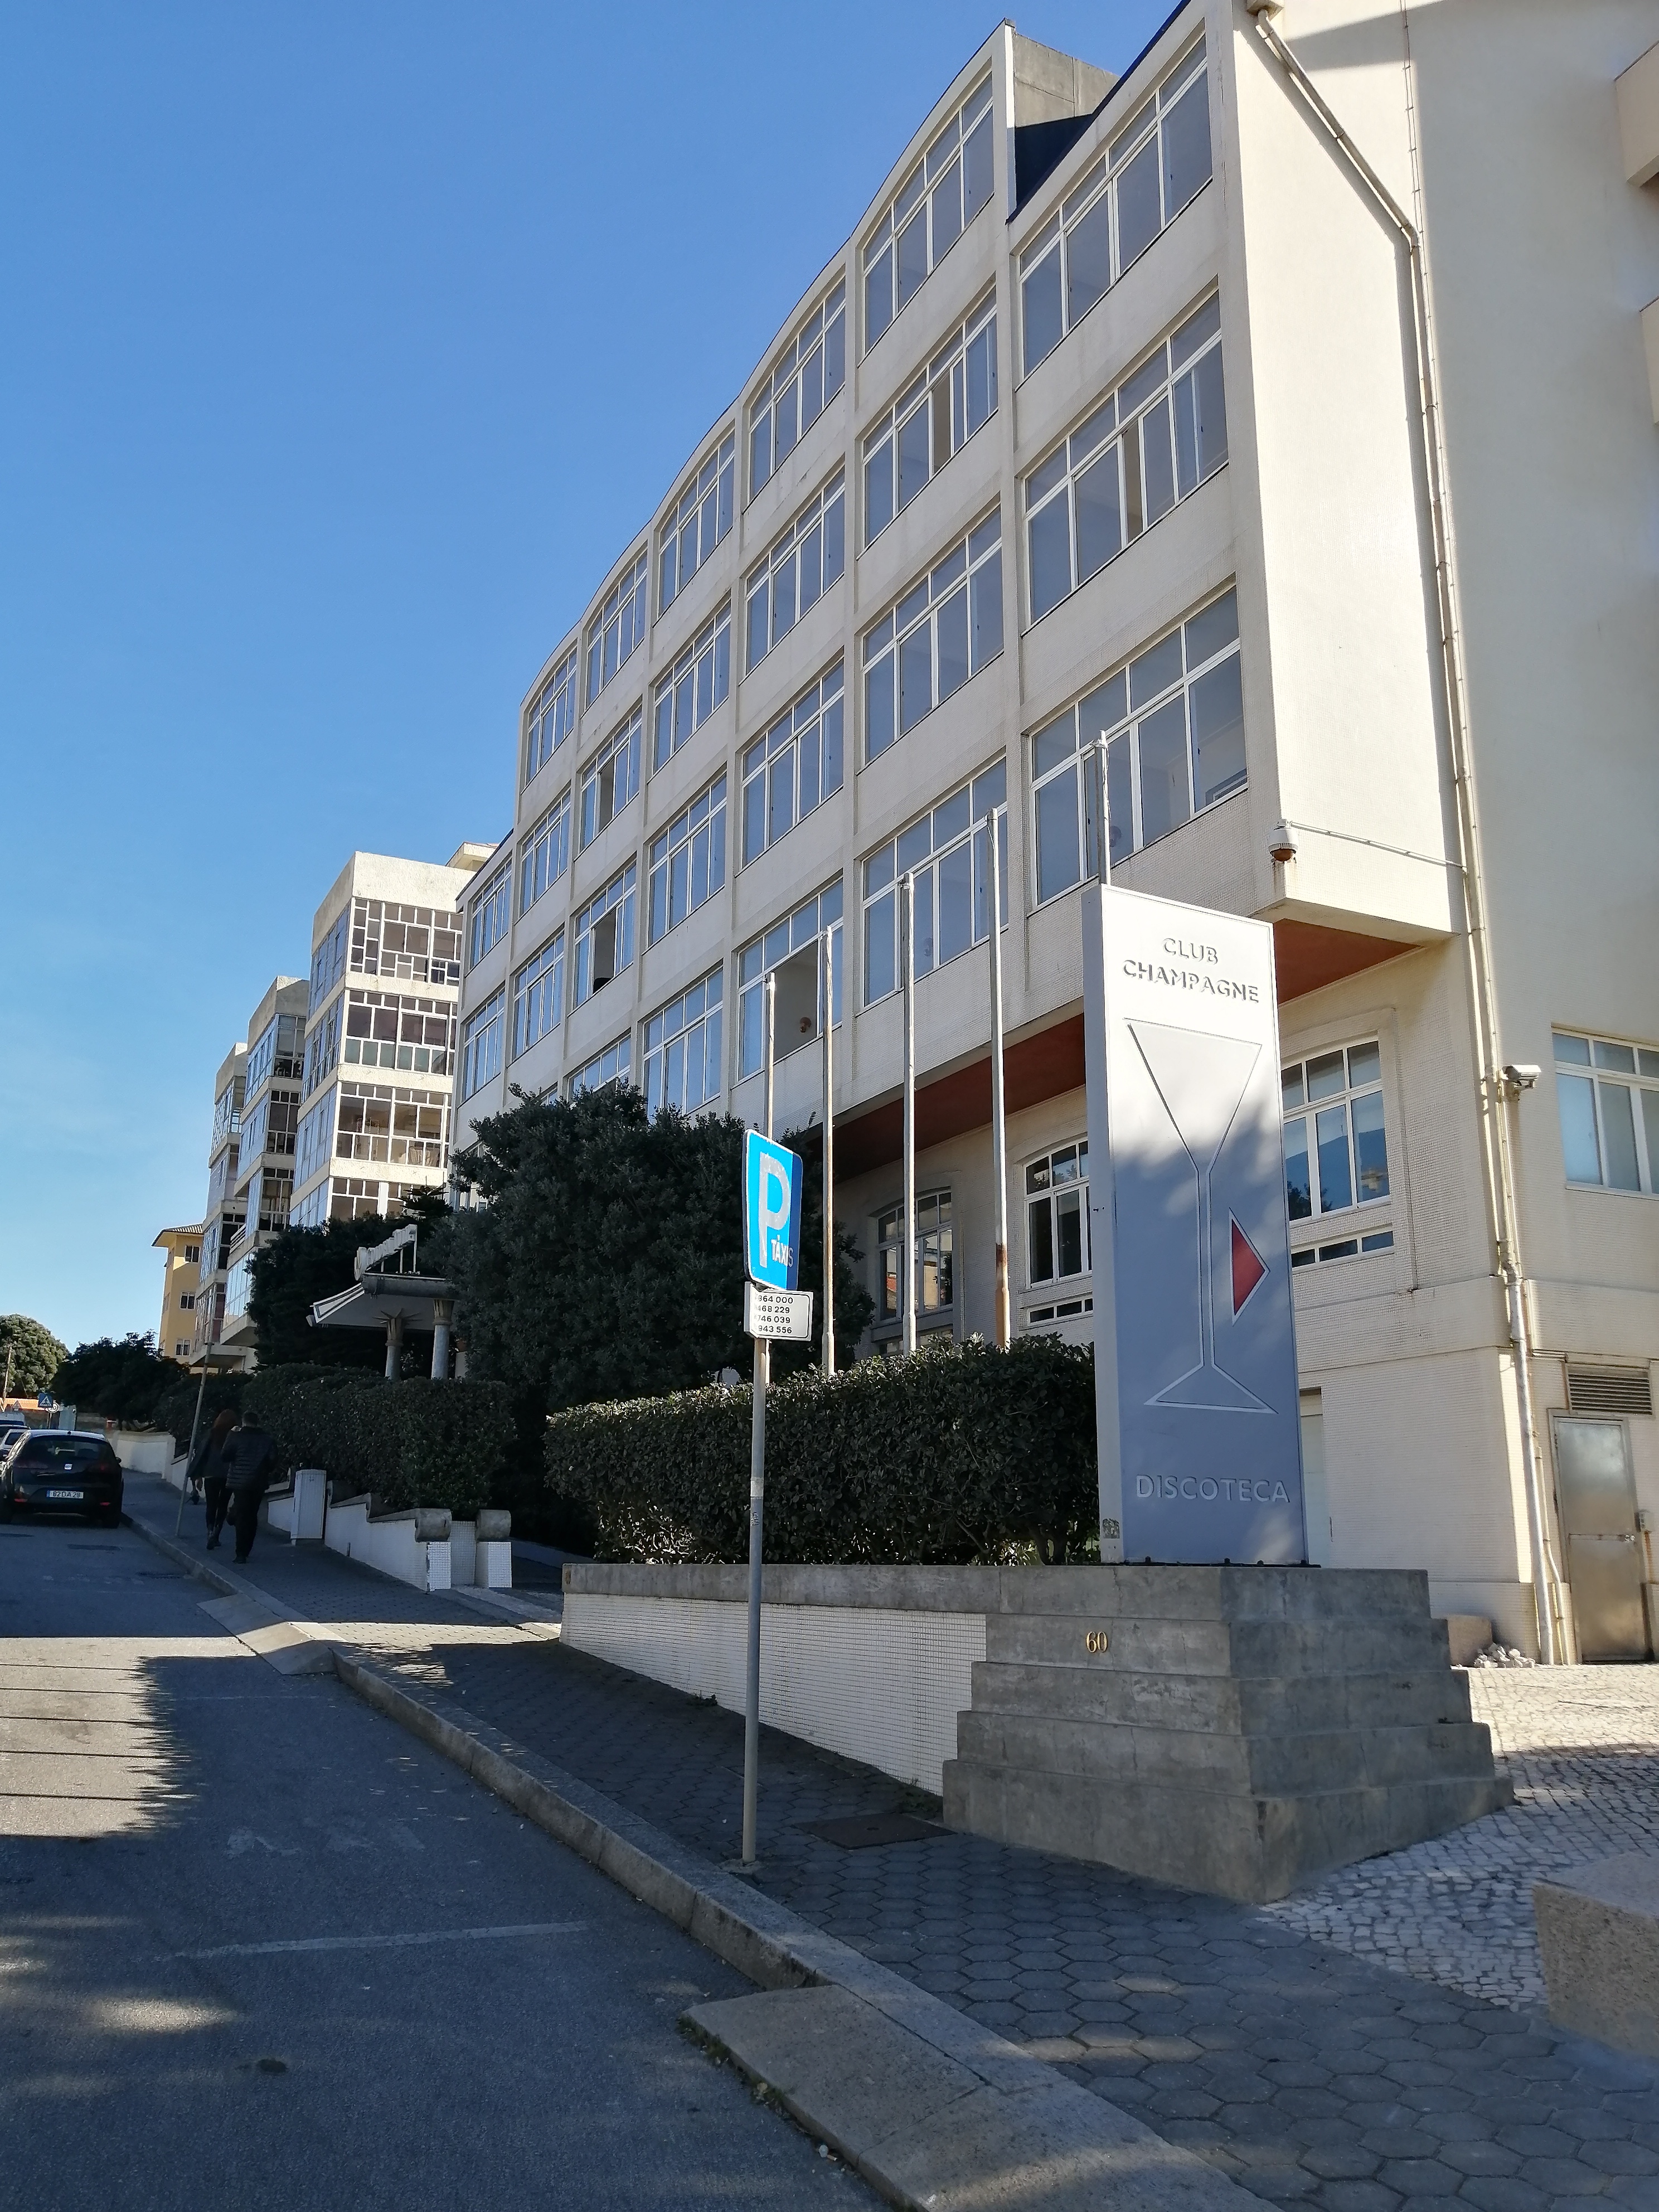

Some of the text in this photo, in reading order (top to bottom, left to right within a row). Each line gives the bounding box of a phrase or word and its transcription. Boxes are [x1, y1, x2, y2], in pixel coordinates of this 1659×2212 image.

[1162, 937, 1218, 966] CLUB
[1122, 959, 1259, 1003] CHAMPAGNE
[758, 1151, 790, 1269] P
[770, 1234, 794, 1268] TÁXIS
[774, 1306, 790, 1314] 229
[774, 1316, 791, 1324] 039
[1136, 1474, 1291, 1503] DISCOTECA
[1086, 1631, 1108, 1653] 60
